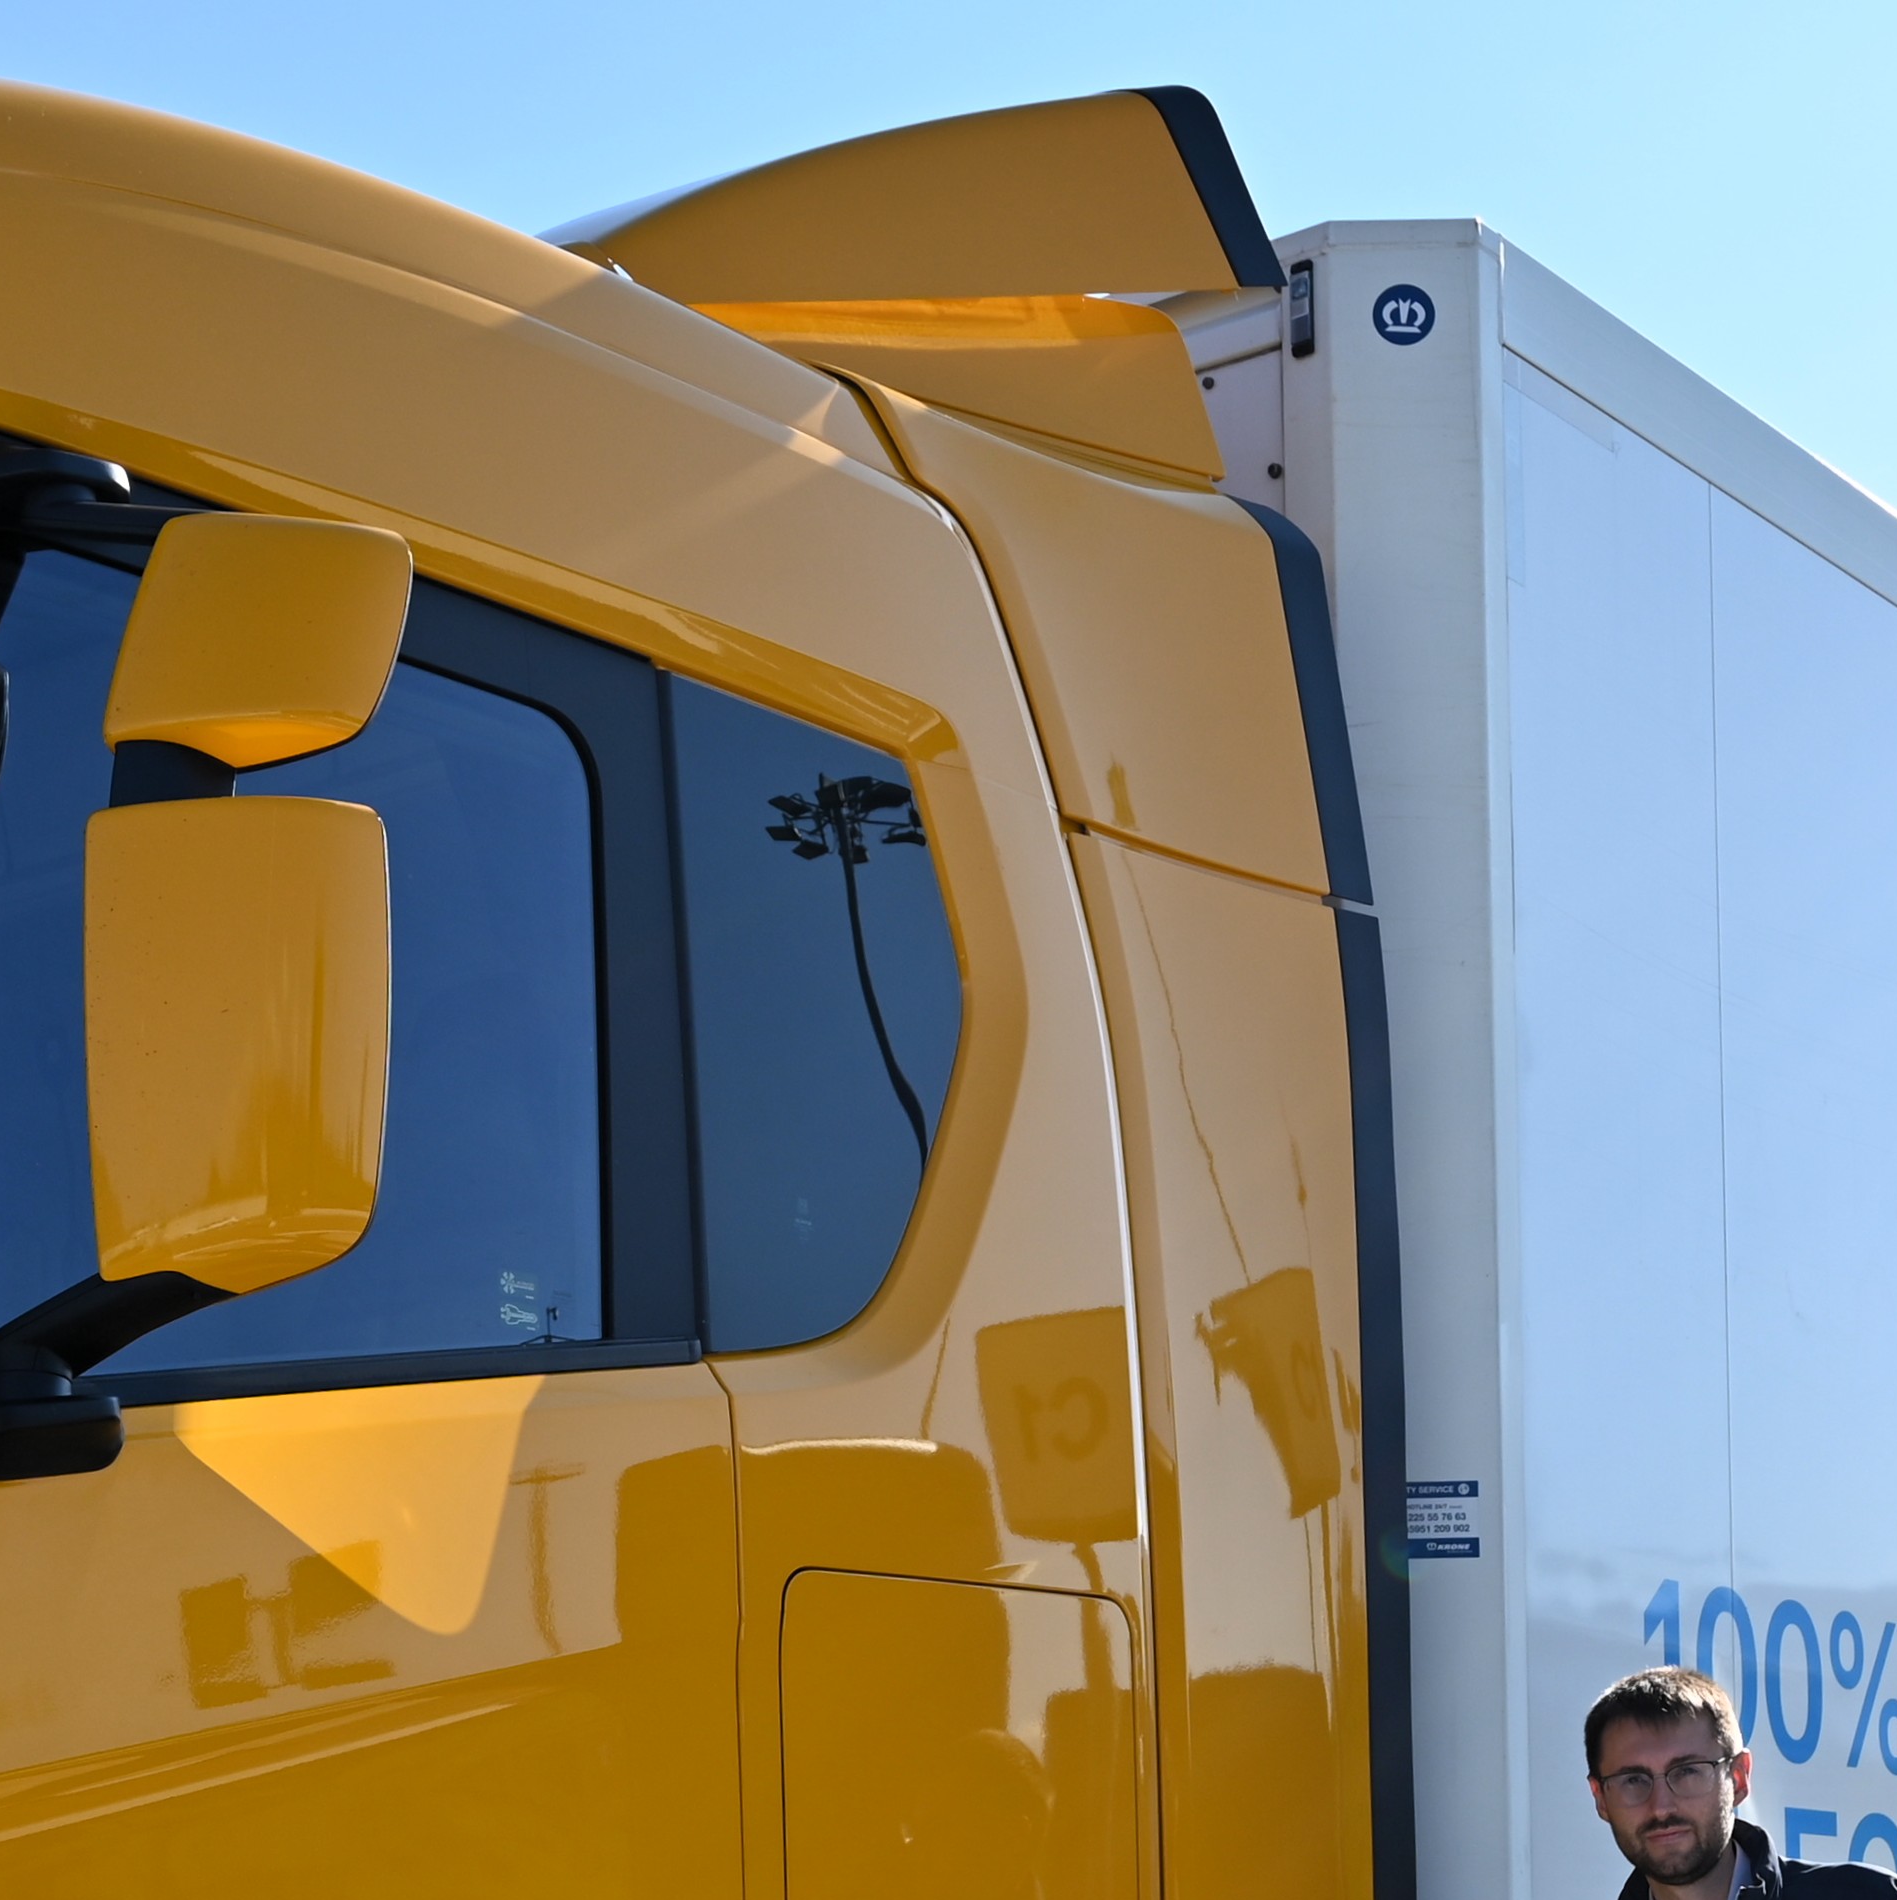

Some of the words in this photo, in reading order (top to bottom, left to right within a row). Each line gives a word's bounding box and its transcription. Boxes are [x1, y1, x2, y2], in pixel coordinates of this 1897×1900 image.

[1418, 1485, 1454, 1494] SERVICE
[1427, 1513, 1439, 1521] 55
[1441, 1512, 1453, 1521] 76
[1455, 1512, 1466, 1521] 63
[1434, 1524, 1451, 1533] 209
[1453, 1524, 1470, 1533] 902
